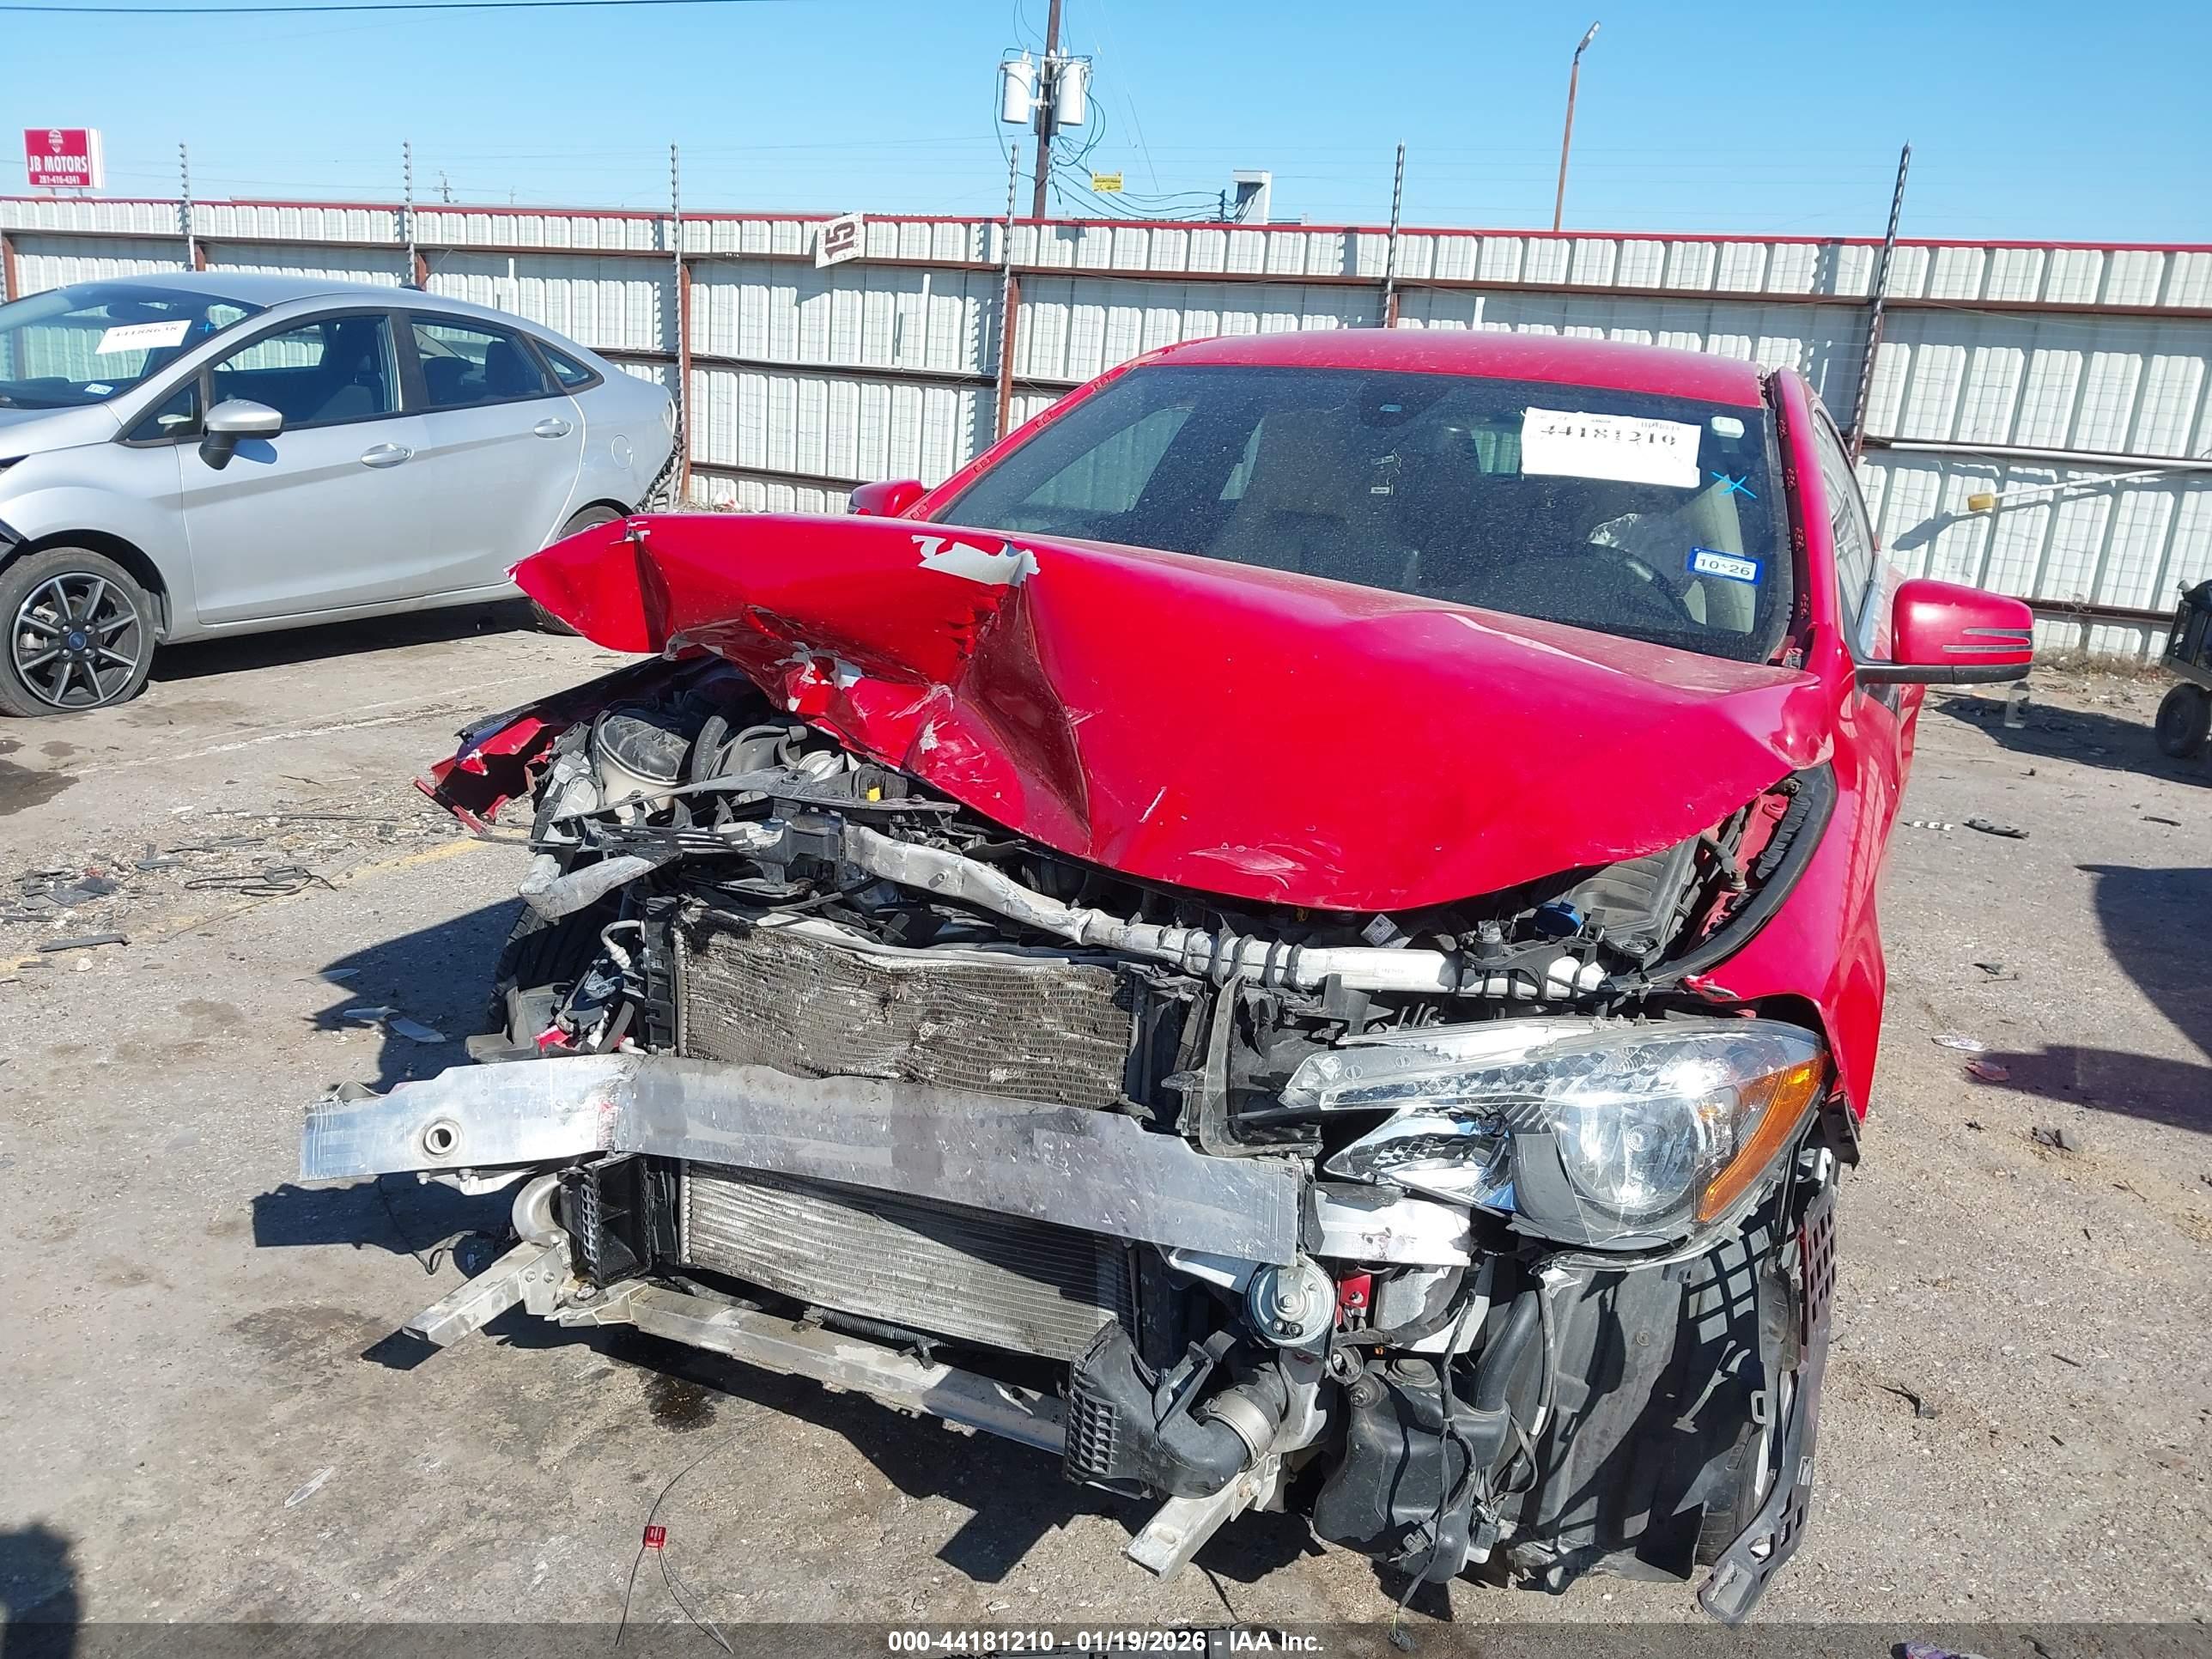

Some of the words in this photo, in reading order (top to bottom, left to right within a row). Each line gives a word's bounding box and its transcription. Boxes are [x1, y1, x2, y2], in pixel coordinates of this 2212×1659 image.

[29, 155, 41, 172] JB
[44, 155, 88, 173] MOTORS
[825, 222, 854, 259] 15
